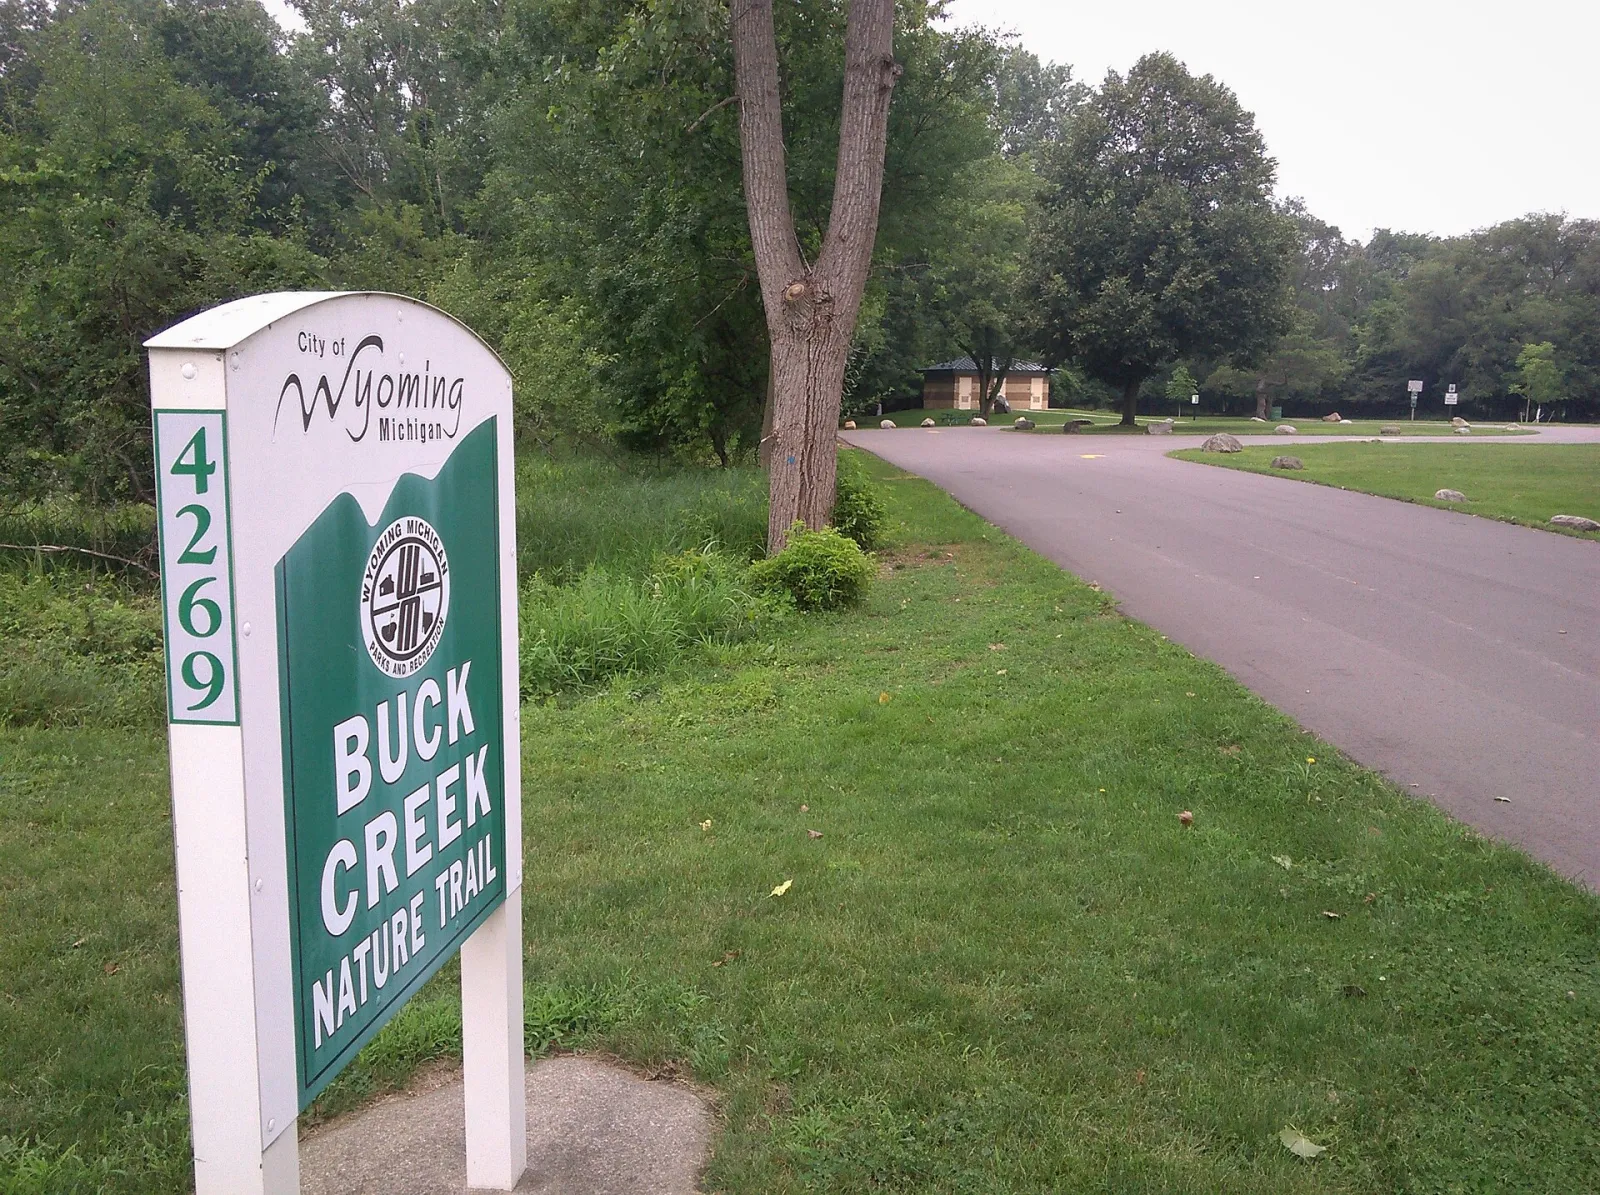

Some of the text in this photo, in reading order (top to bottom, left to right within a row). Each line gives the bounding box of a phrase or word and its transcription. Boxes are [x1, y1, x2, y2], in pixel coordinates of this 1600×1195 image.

[272, 334, 464, 443] Wyoming
[298, 331, 346, 358] City of
[379, 417, 442, 444] Michigan
[170, 426, 226, 711] 4269
[362, 519, 448, 603] WYOMING MICHIGAN
[369, 617, 445, 675] PARKS AND RECREATION
[333, 660, 475, 816] BUCK
[320, 744, 492, 937] CREEK
[312, 833, 497, 1051] NATURE TRAIL
